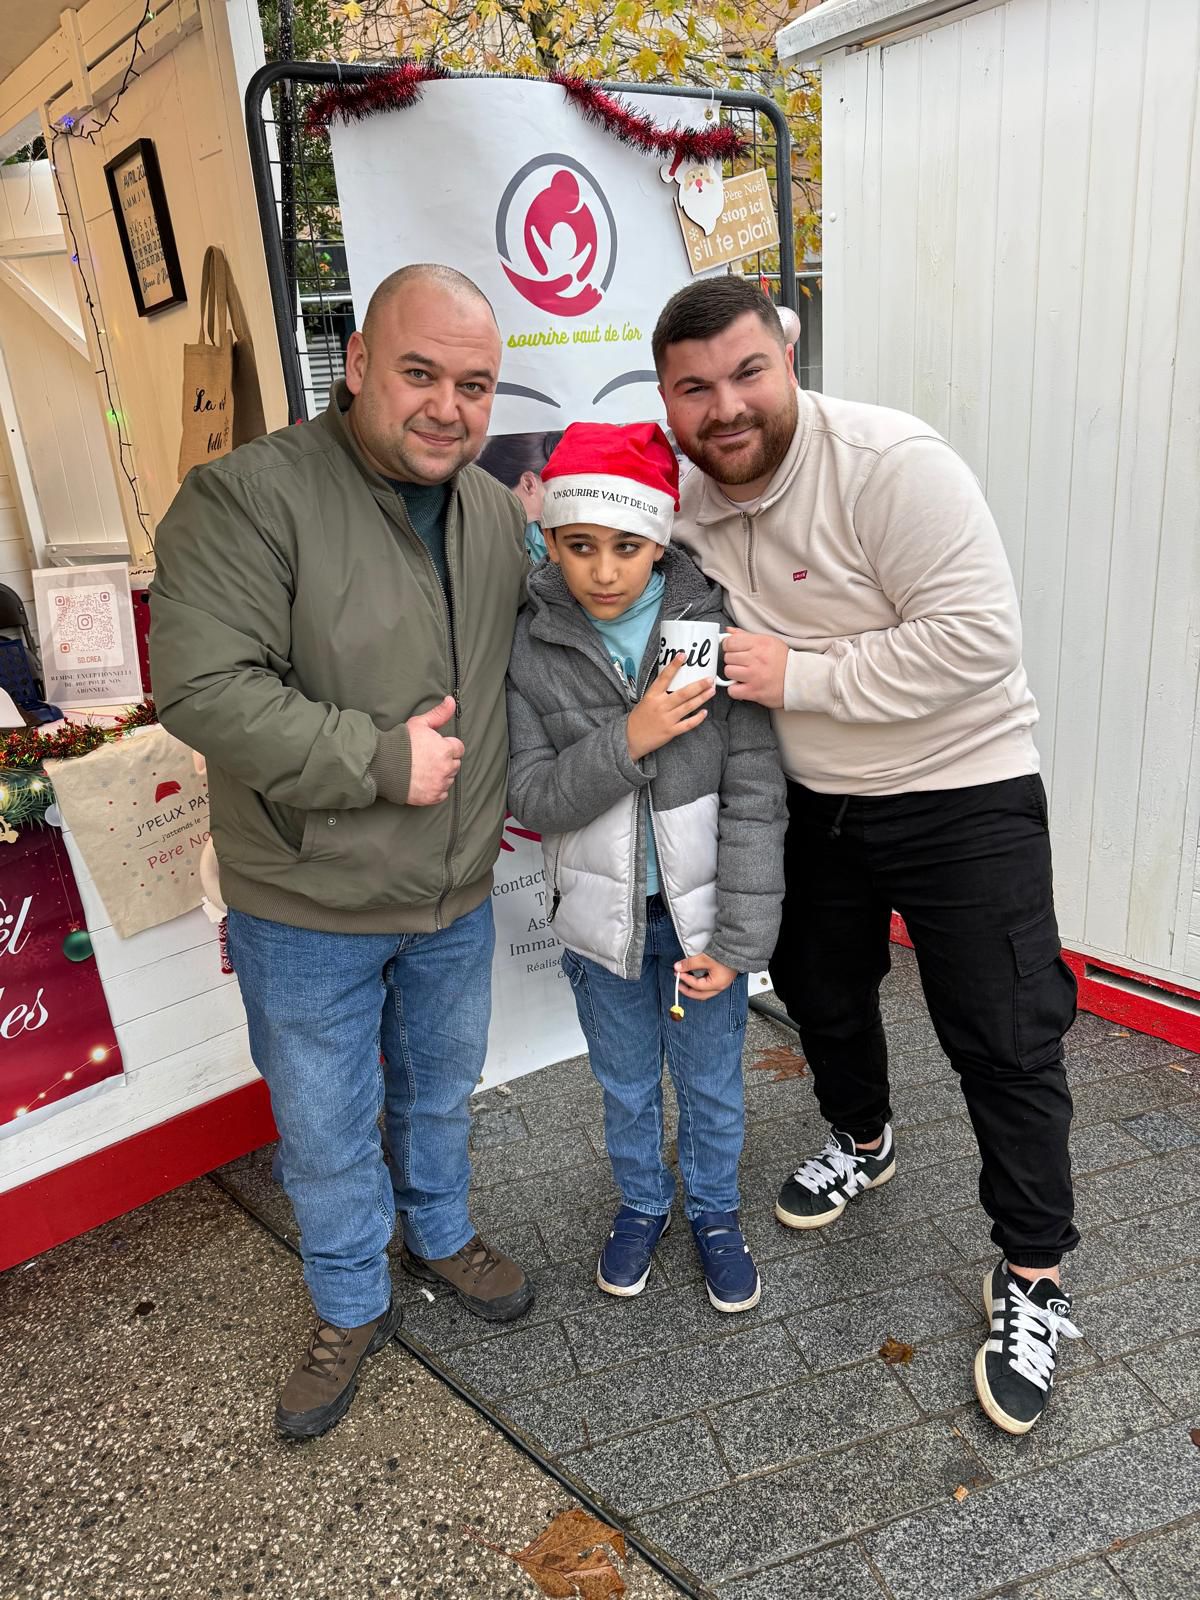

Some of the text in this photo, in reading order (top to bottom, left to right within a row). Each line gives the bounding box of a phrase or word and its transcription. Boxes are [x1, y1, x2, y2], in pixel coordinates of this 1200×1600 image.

[743, 178, 766, 196] Noël
[721, 198, 764, 224] stop ici
[694, 216, 773, 261] s'il te plaît
[507, 321, 642, 348] sourire vaut de l'or
[193, 388, 216, 412] La
[561, 488, 600, 498] SOURIRE
[601, 491, 630, 504] VAUT
[630, 498, 642, 509] DE
[643, 502, 659, 516] L'OR
[136, 805, 186, 838] J'PEUX
[161, 822, 194, 843] j'attends
[147, 845, 184, 869] Père
[535, 891, 547, 906] T
